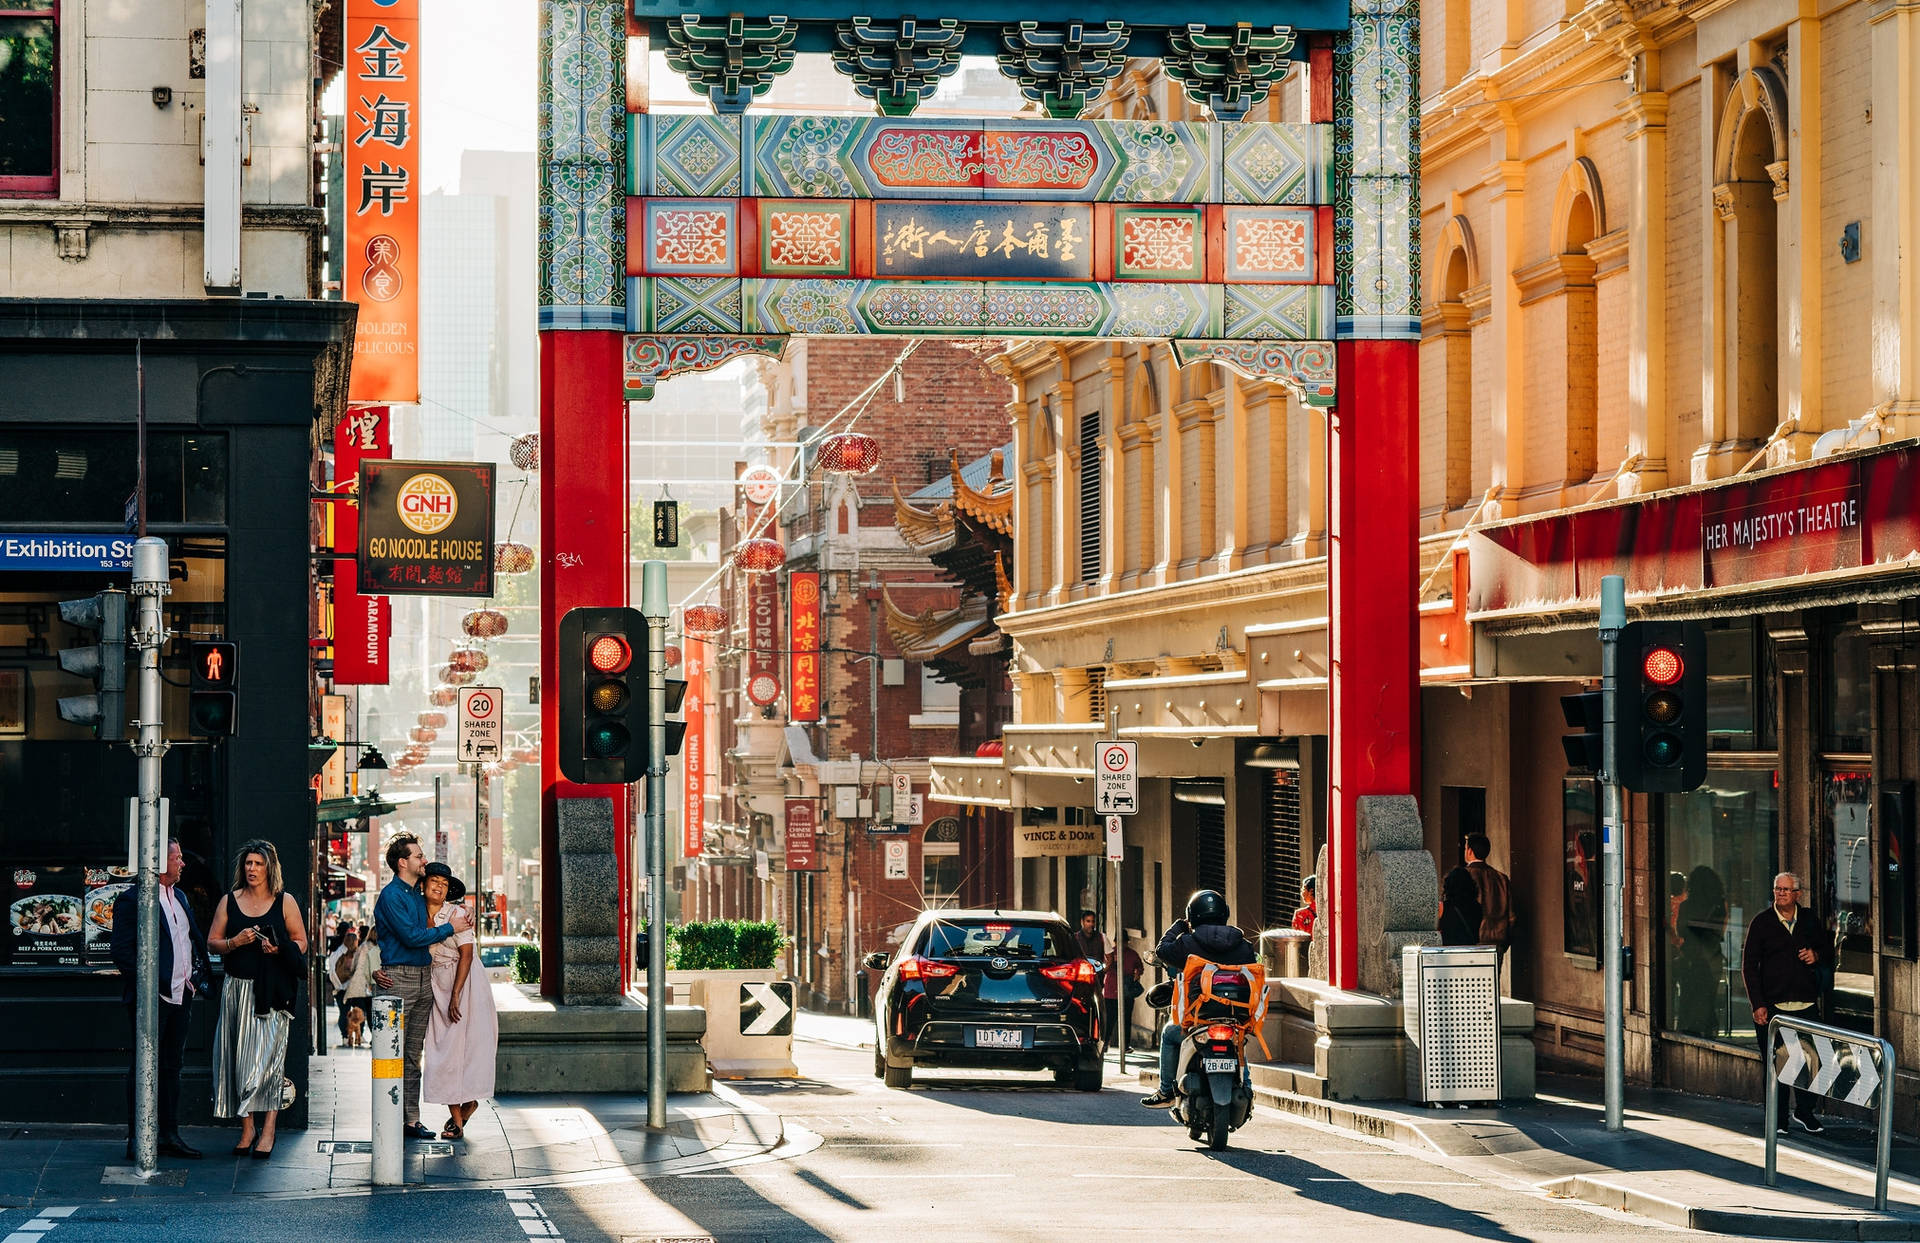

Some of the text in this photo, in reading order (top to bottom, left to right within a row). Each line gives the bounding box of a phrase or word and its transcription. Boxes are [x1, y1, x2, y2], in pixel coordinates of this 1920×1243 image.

[354, 24, 411, 217] 金海岸
[372, 240, 393, 298] 美食
[356, 322, 407, 335] GOLDEN
[402, 494, 452, 513] GNH
[1706, 500, 1857, 550] HER MAJESTY'S THEATRE
[6, 540, 133, 558] Exhibition St
[369, 537, 483, 561] GO NOODLE HOUSE
[367, 594, 379, 665] PARAMOUNT
[756, 595, 772, 670] GOURMET
[795, 611, 816, 713] 北京同仁堂
[472, 700, 489, 711] 20
[464, 721, 497, 729] SHARED
[469, 730, 491, 738] ZONE
[1108, 753, 1125, 765] 20
[1101, 773, 1132, 781] SHARED
[1106, 782, 1127, 790] ZONE
[690, 734, 699, 849] EMPRESS OF CHINA
[1024, 831, 1095, 841] VINCE & DOM
[1002, 1030, 1021, 1043] 2FJ
